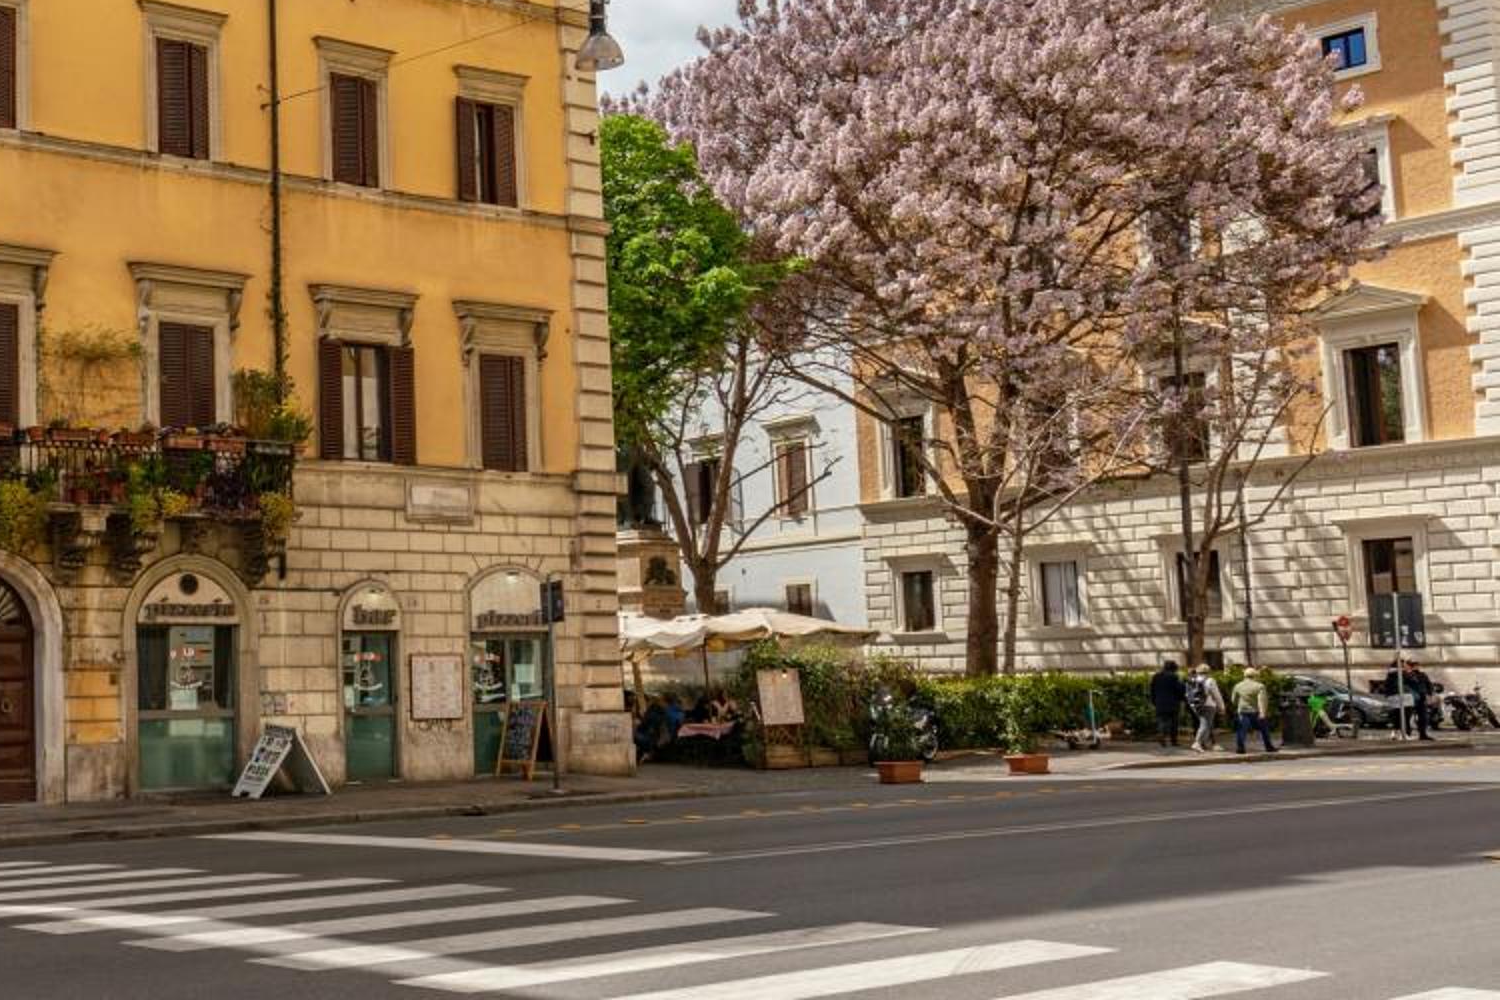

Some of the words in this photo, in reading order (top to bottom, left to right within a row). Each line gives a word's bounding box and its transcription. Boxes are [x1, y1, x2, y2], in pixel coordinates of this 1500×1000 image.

[143, 596, 235, 620] pizzeria
[352, 604, 397, 625] bar
[476, 609, 549, 630] pizzeri
